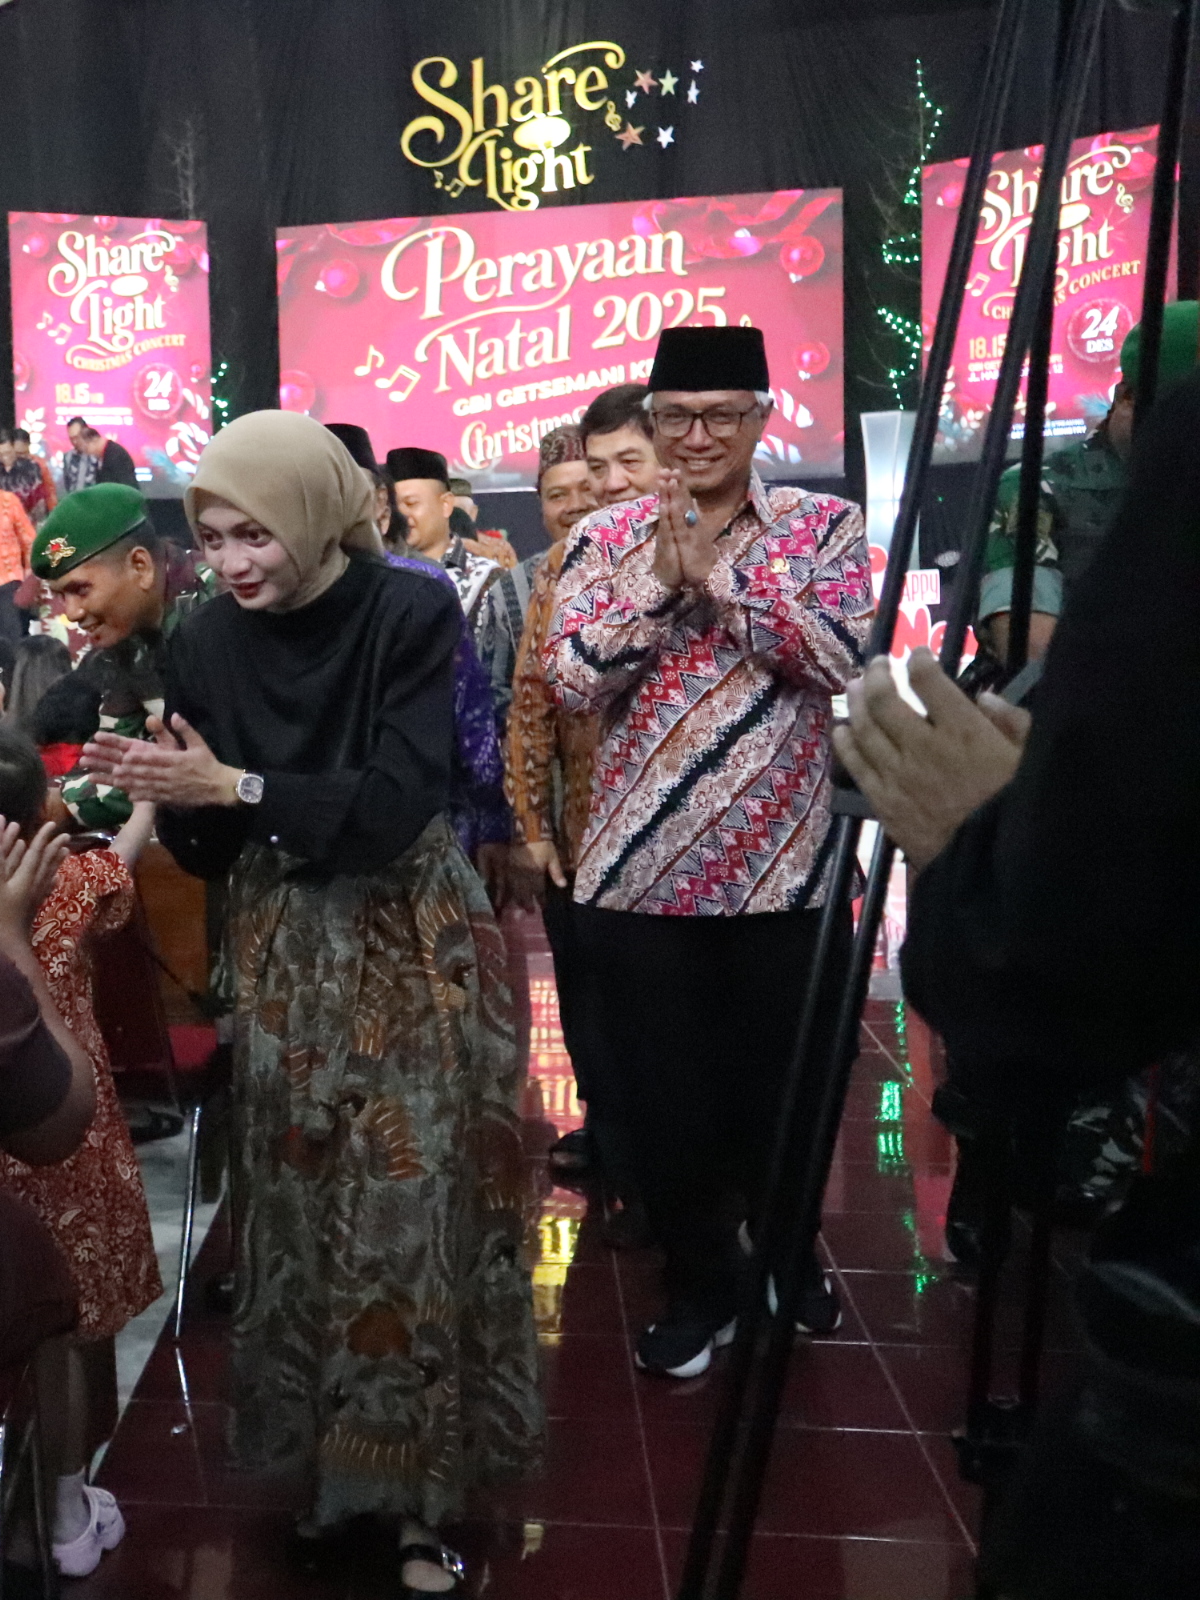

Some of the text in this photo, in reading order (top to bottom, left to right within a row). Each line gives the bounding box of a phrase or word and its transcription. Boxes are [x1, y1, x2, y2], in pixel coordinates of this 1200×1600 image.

[401, 40, 625, 167] Share
[458, 128, 594, 211] Light
[48, 230, 176, 297] Share
[381, 226, 688, 320] Perayaan
[1068, 260, 1141, 294] CONCERT
[70, 280, 166, 352] Light
[433, 286, 728, 393] Natal 2025
[1081, 305, 1120, 339] 24
[1086, 338, 1114, 353] DES
[144, 371, 174, 398] 24
[496, 364, 626, 408] GETSEMANI
[903, 573, 939, 602] APPY
